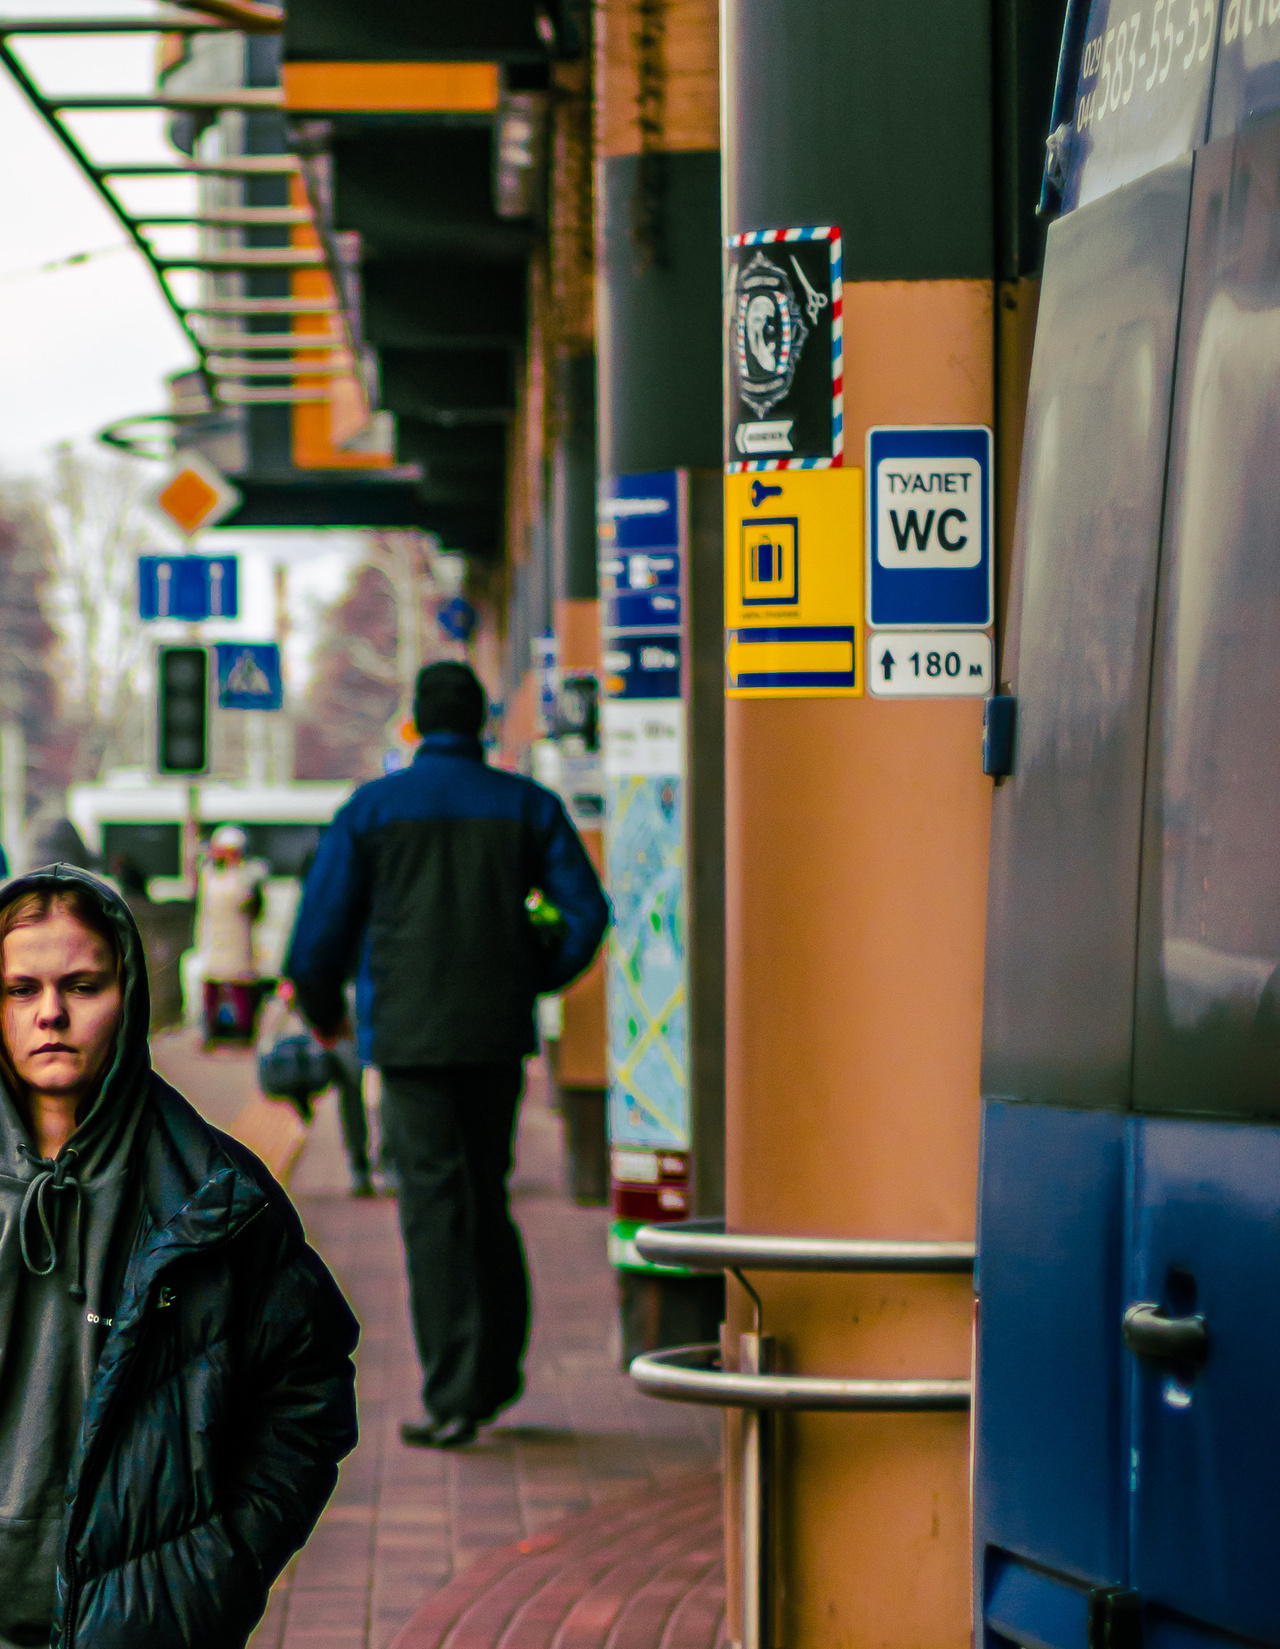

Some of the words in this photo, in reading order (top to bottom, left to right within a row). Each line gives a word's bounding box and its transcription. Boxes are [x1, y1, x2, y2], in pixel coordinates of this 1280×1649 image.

[1083, 35, 1102, 79] 029
[886, 473, 972, 493] ТУАЛЕТ
[889, 508, 967, 551] WC
[909, 651, 960, 676] 180
